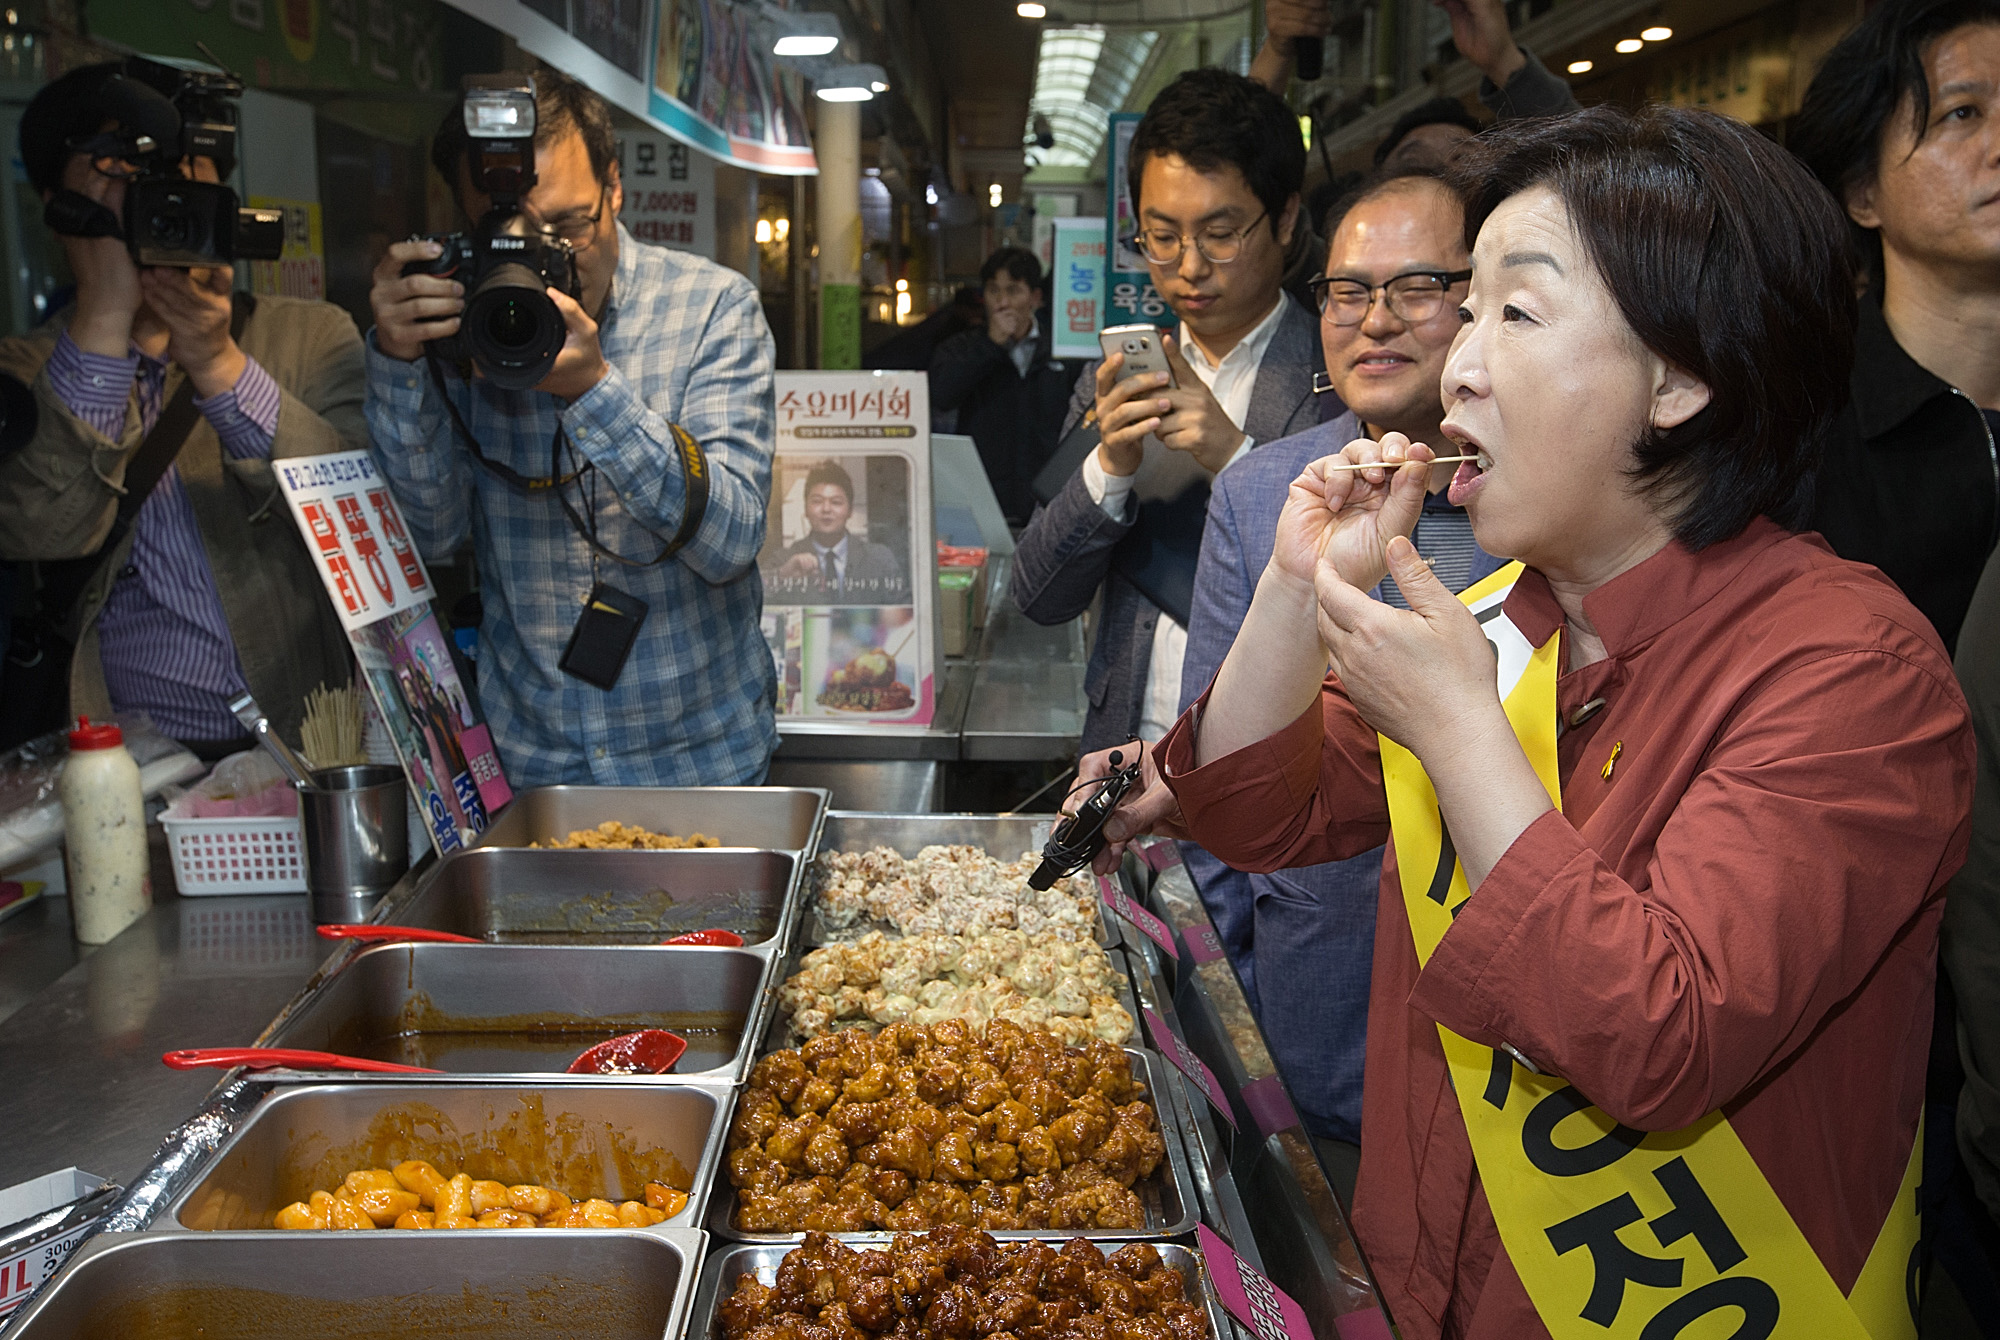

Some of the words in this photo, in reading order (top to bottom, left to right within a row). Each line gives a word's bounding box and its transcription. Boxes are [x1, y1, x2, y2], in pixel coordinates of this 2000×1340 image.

[631, 190, 698, 214] 7,000원
[490, 238, 526, 250] Nikon
[1067, 298, 1104, 333] 햅
[1112, 282, 1177, 317] 육중
[778, 386, 912, 422] 수요미식회
[299, 486, 428, 616] 닭똥집
[469, 750, 500, 785] 닭똥집
[428, 769, 488, 854] 육중
[1232, 1252, 1287, 1329] 닭강정
